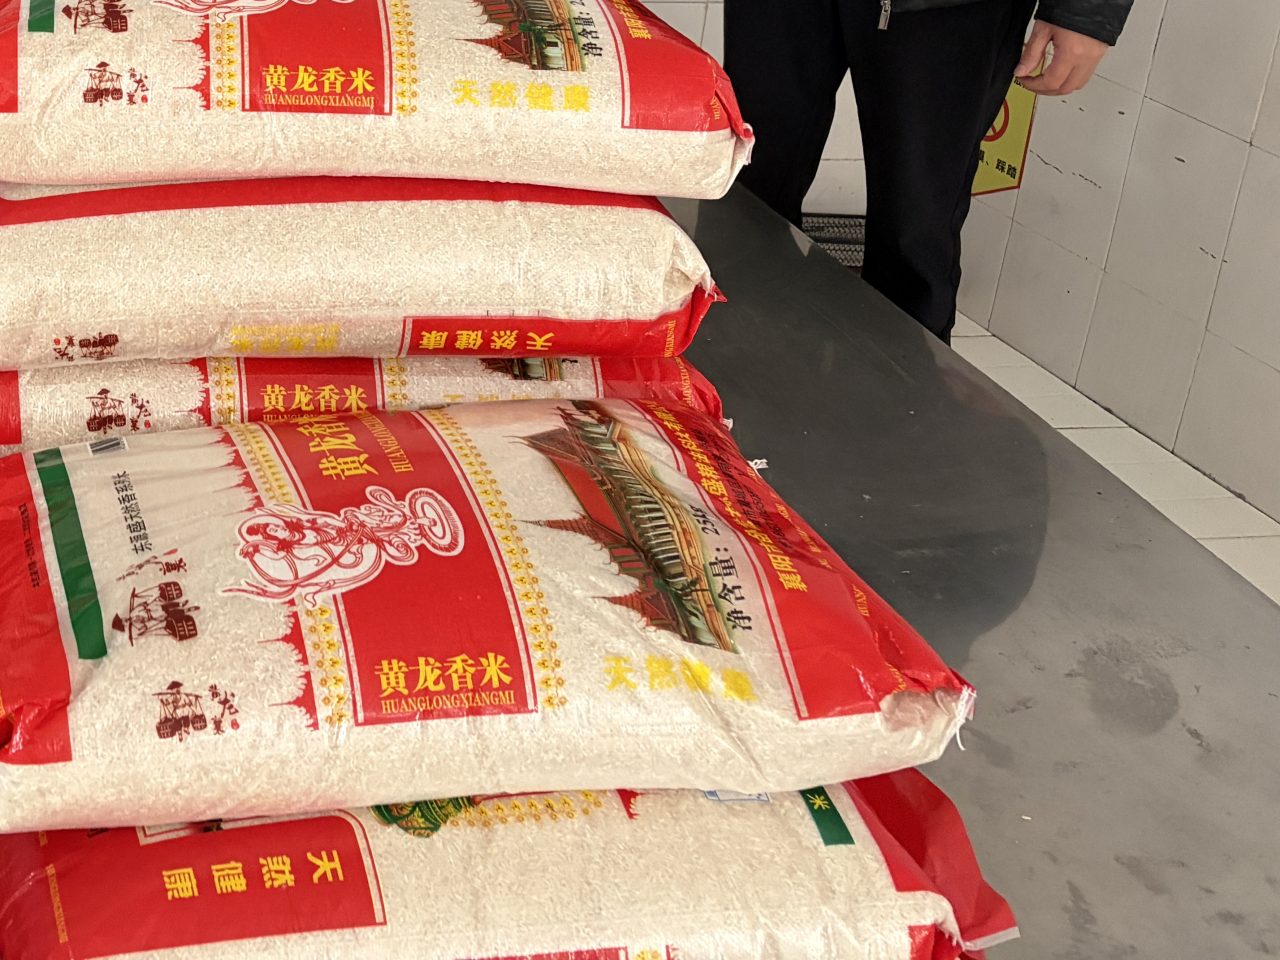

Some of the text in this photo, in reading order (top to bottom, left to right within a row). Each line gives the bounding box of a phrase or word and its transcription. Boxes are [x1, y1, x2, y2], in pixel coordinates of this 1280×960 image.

[263, 64, 376, 94] 黄龙香米
[264, 94, 375, 107] HUANGLONGXIANGMI
[418, 330, 555, 351] 天然健康
[260, 384, 369, 414] 黄龙香米
[374, 652, 513, 699] 黄龙香米
[380, 690, 516, 713] HUANGLONGXIANGMI
[162, 850, 345, 901] 天然健康
